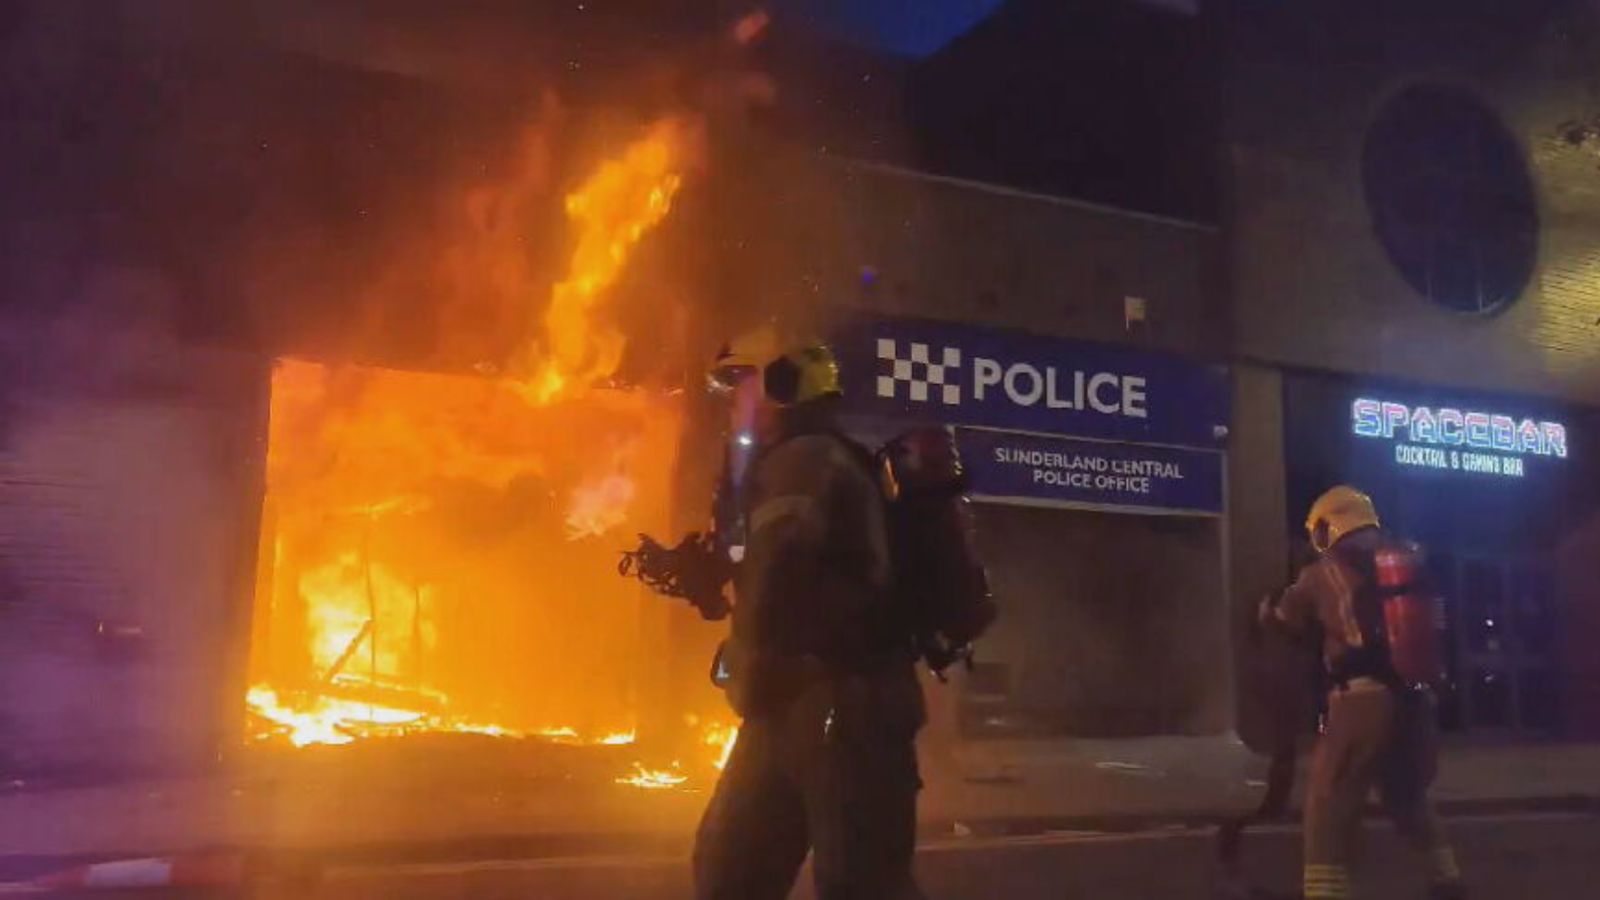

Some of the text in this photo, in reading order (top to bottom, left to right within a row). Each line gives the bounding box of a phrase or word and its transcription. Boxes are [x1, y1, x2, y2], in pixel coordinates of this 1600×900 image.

[974, 357, 1148, 418] POLICE
[1352, 398, 1568, 458] SPACEBAR
[995, 447, 1184, 479] SUNDERLAND CENTRAL
[1396, 445, 1523, 477] COCKTAIL & GAMING BAR
[1033, 470, 1150, 493] POLICE OFFICE
